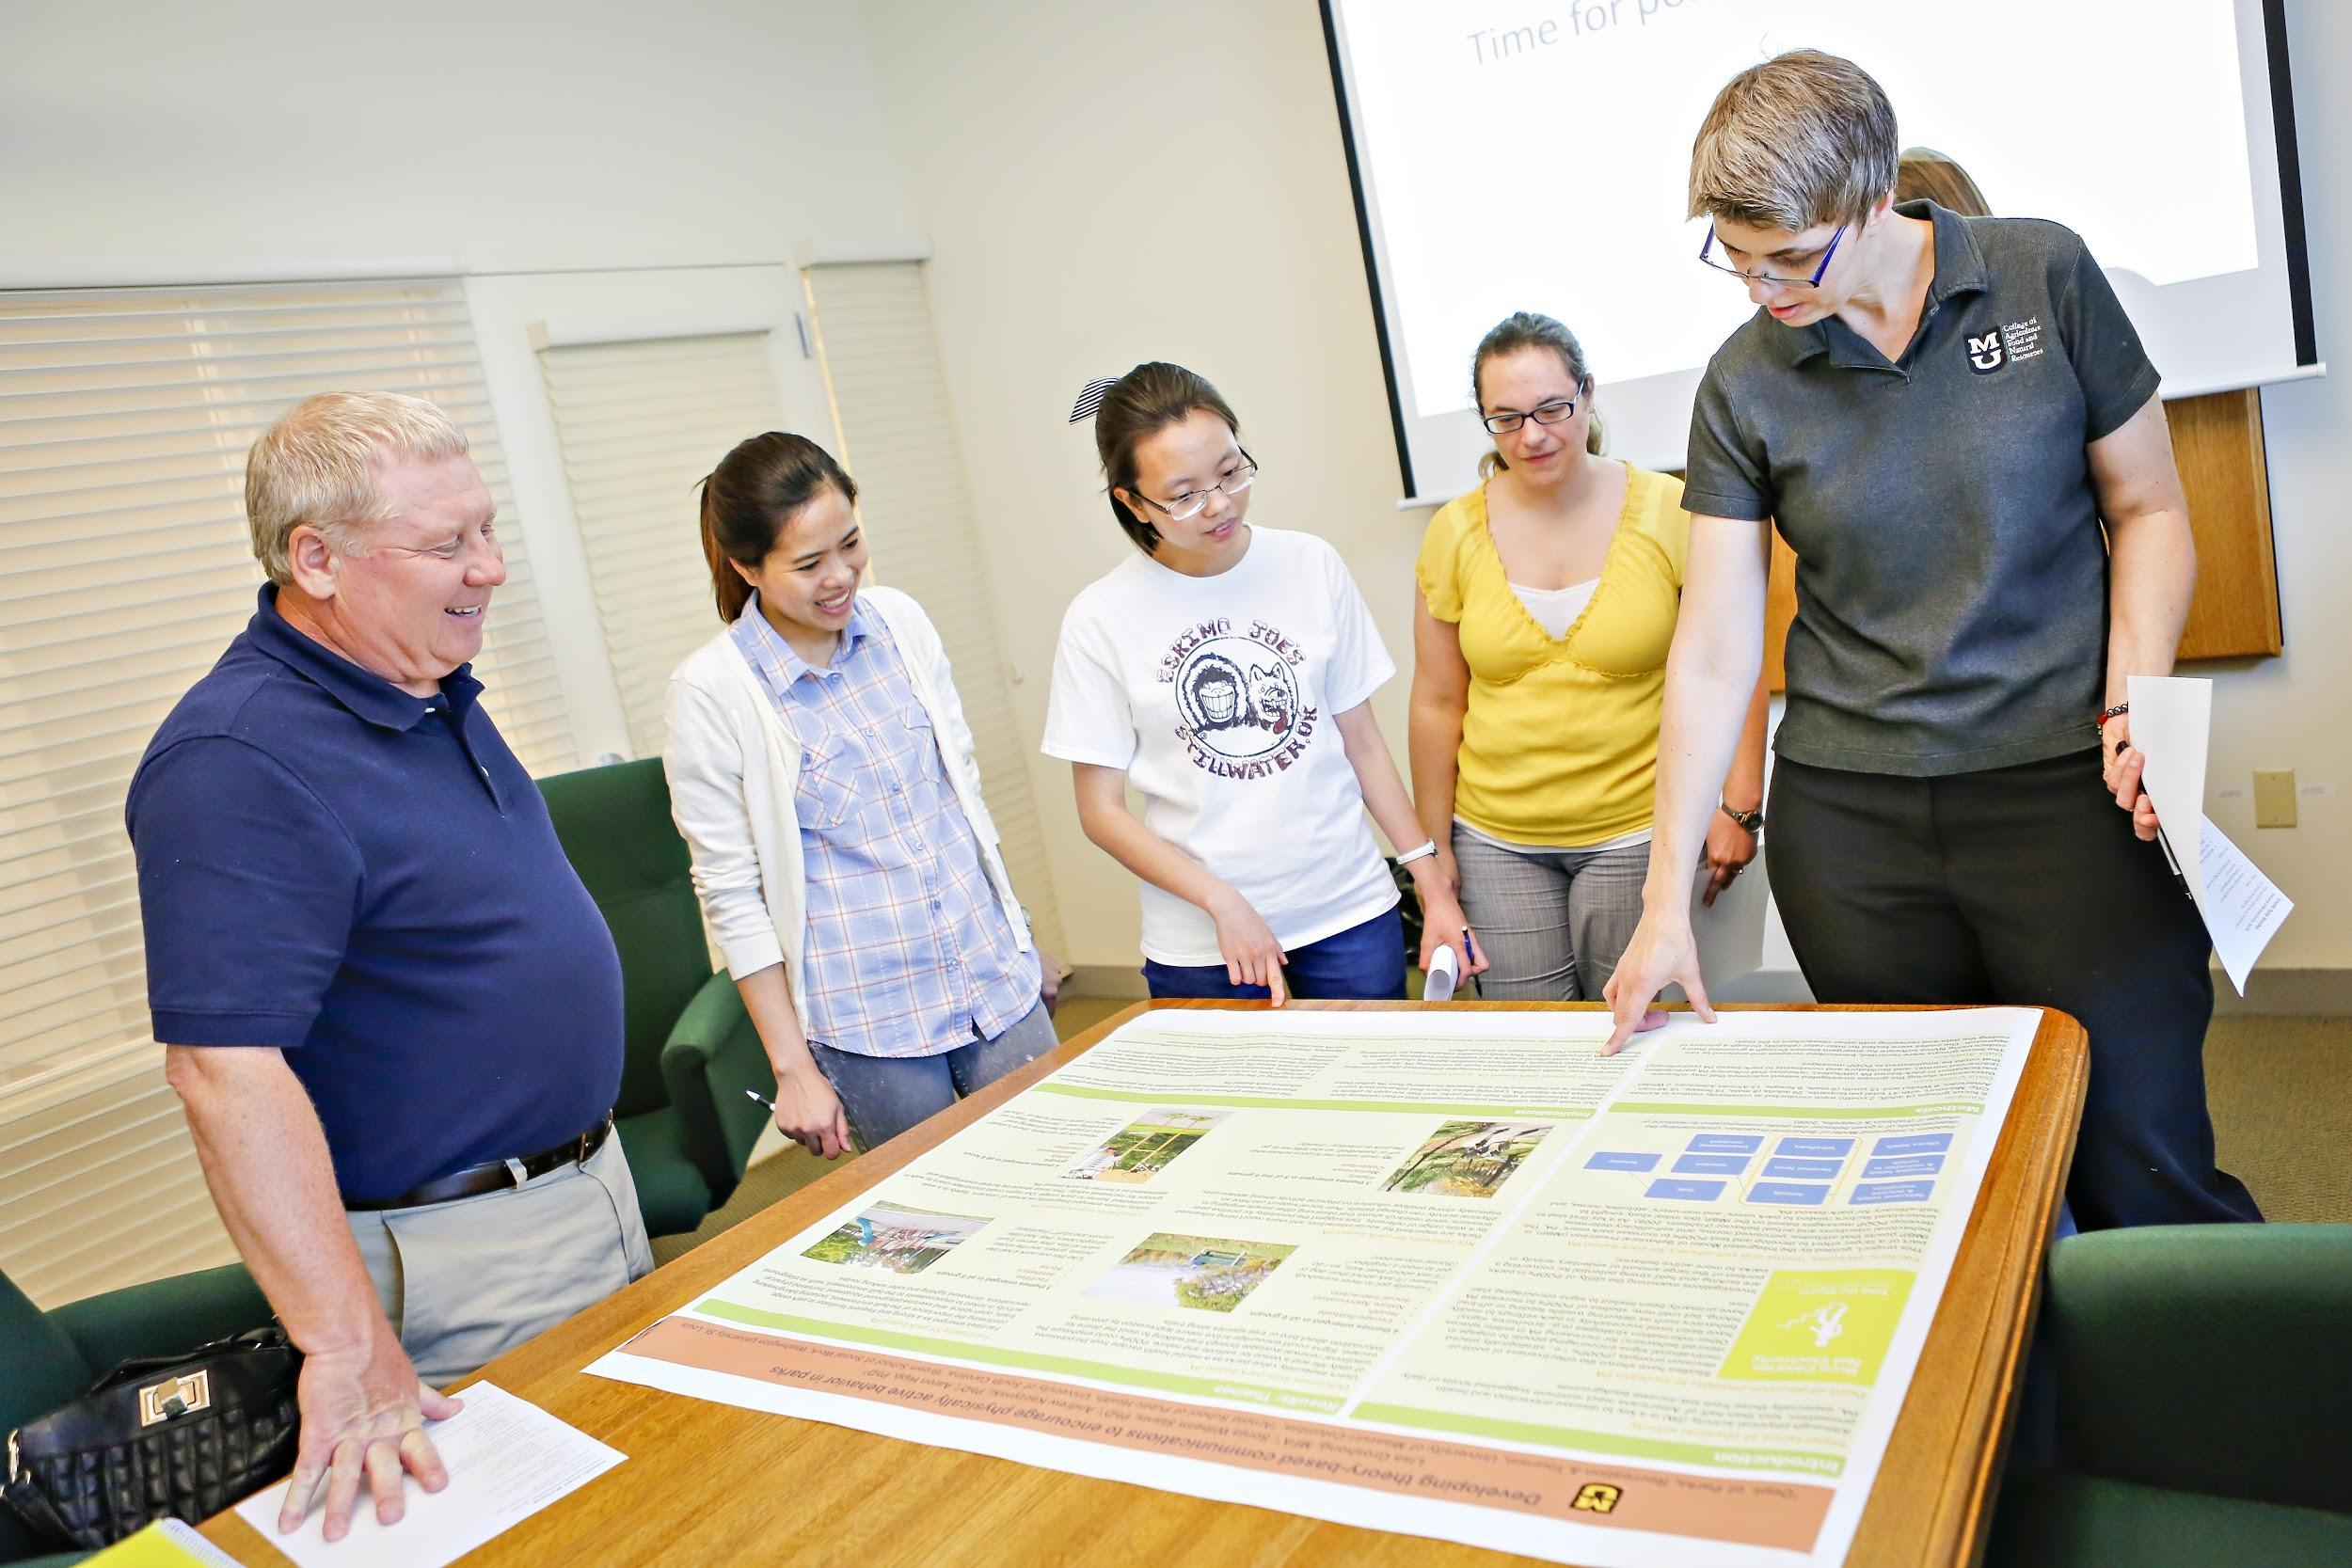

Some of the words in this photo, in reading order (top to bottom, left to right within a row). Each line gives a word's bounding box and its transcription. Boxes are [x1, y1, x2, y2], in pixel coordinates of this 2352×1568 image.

[1466, 20, 1558, 65] Time
[1570, 0, 1622, 36] for
[1638, 0, 1683, 25] p
[2003, 321, 2028, 332] College
[2029, 316, 2038, 325] of
[2007, 338, 2025, 347] Food
[2026, 332, 2039, 342] and
[2009, 342, 2035, 355] Natural
[2010, 348, 2044, 362] Resources
[1156, 617, 1232, 683] ESKIMO
[1296, 705, 1317, 737] OK
[1512, 1108, 1593, 1117] Implications
[765, 1365, 812, 1379] parks
[805, 1373, 824, 1382] in
[819, 1376, 887, 1393] behavior
[1035, 1384, 1094, 1400] University
[1209, 1385, 1274, 1401] Themes
[882, 1387, 935, 1402] active
[1274, 1394, 1341, 1411] Results:
[930, 1393, 1015, 1417] physically
[1046, 1400, 1095, 1413] Andrew
[1010, 1407, 1105, 1431] encourage
[1101, 1425, 1125, 1436] to
[1121, 1429, 1277, 1464] communications
[1425, 1444, 1501, 1463] University
[1274, 1451, 1417, 1485] theory-based
[1710, 1451, 1839, 1476] Introduction
[1581, 1467, 1669, 1486] Recreation
[1414, 1473, 1544, 1505] Developing
